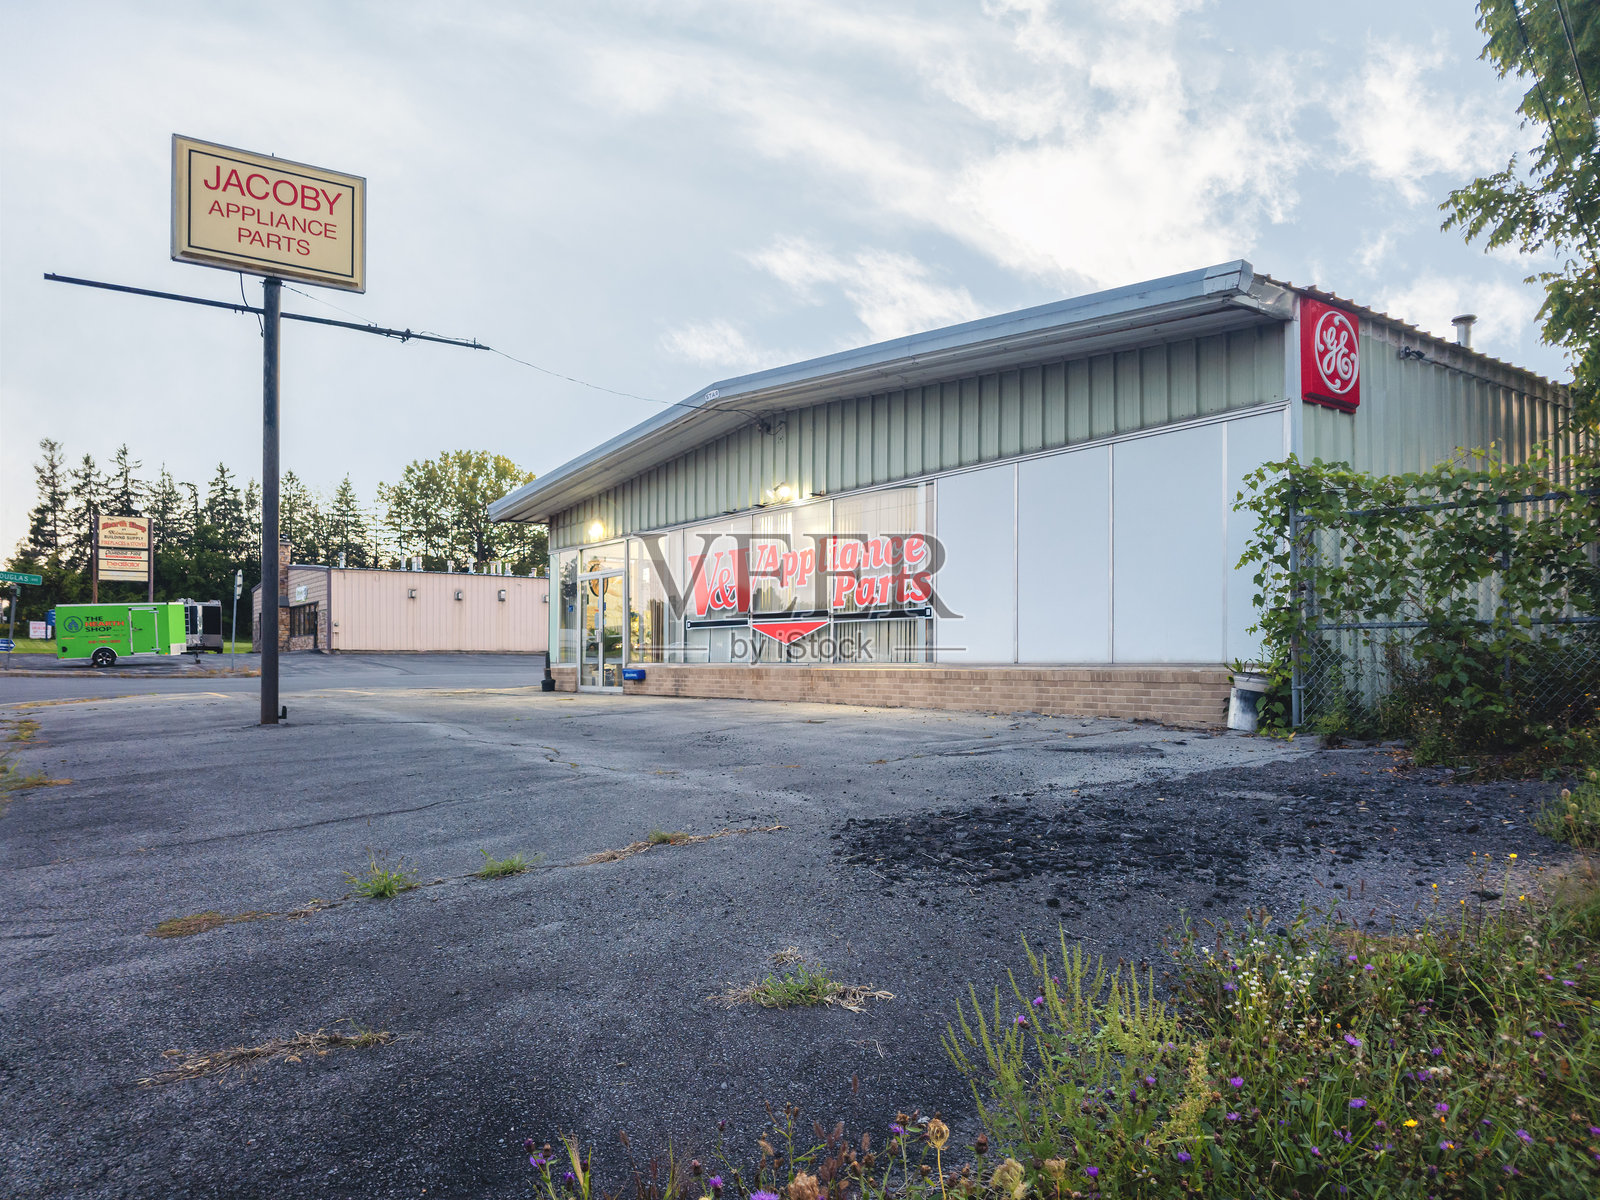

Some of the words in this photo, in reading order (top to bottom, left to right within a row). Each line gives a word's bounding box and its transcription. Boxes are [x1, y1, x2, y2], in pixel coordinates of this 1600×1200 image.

[203, 165, 342, 215] JACOBY
[208, 200, 337, 240] APPLIANCE
[238, 227, 311, 256] PARTS
[760, 533, 926, 588] Appliance
[833, 566, 932, 607] Parts
